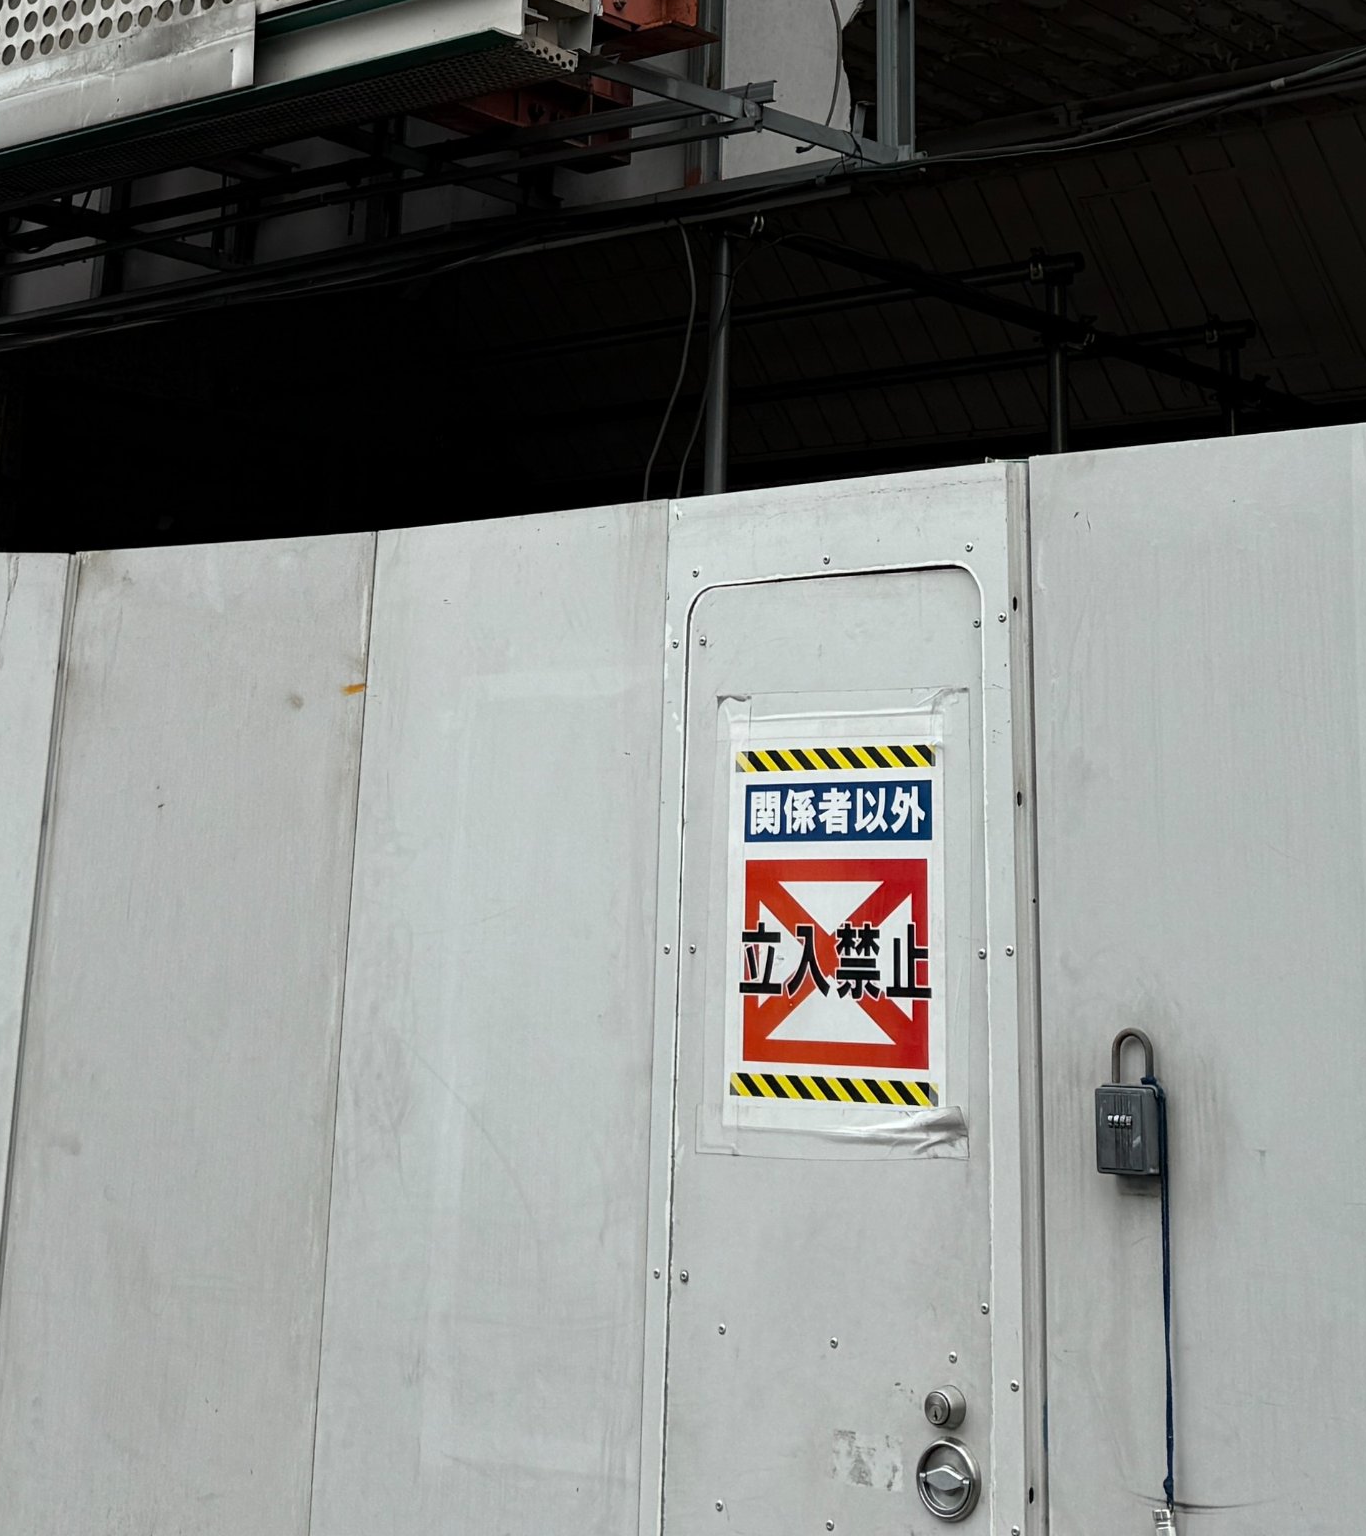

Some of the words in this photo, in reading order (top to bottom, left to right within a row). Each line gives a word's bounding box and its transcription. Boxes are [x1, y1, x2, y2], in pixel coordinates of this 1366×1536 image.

[750, 786, 925, 835] 関係者以外
[739, 922, 932, 999] 立入禁止
